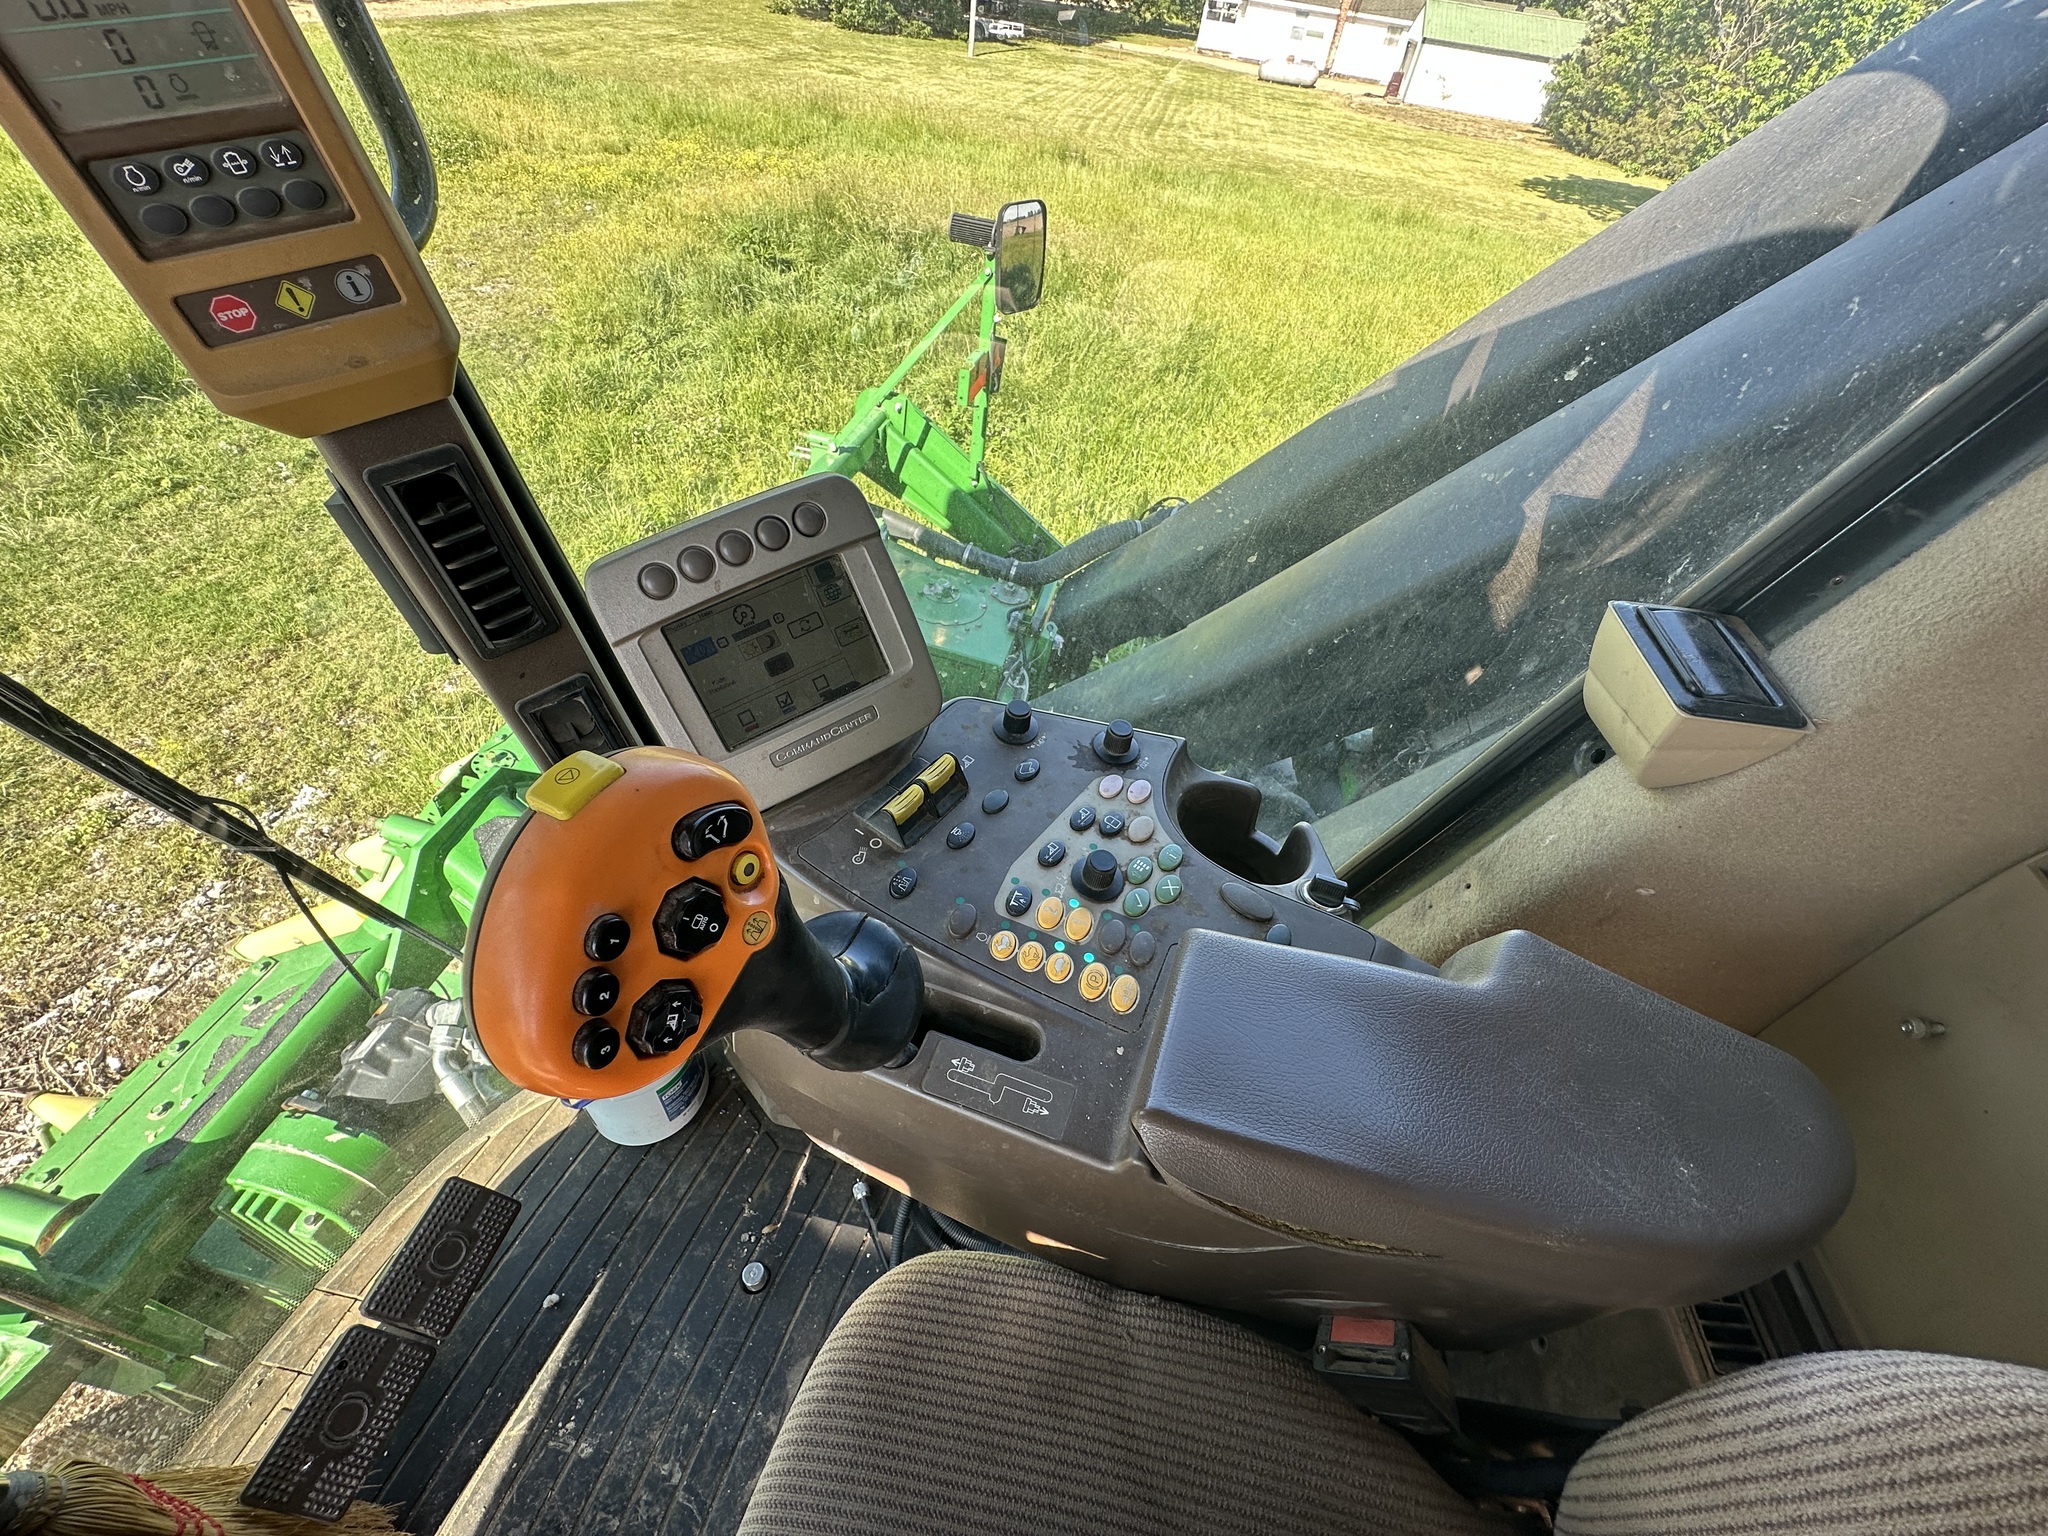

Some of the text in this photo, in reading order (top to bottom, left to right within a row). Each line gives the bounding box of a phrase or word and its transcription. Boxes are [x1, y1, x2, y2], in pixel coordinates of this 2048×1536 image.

[94, 2, 132, 17] MPH
[102, 28, 137, 65] 0
[132, 74, 166, 110] 0
[182, 175, 203, 184] n/min
[217, 307, 249, 322] STOP
[599, 991, 610, 1001] 2
[600, 1045, 611, 1055] 3
